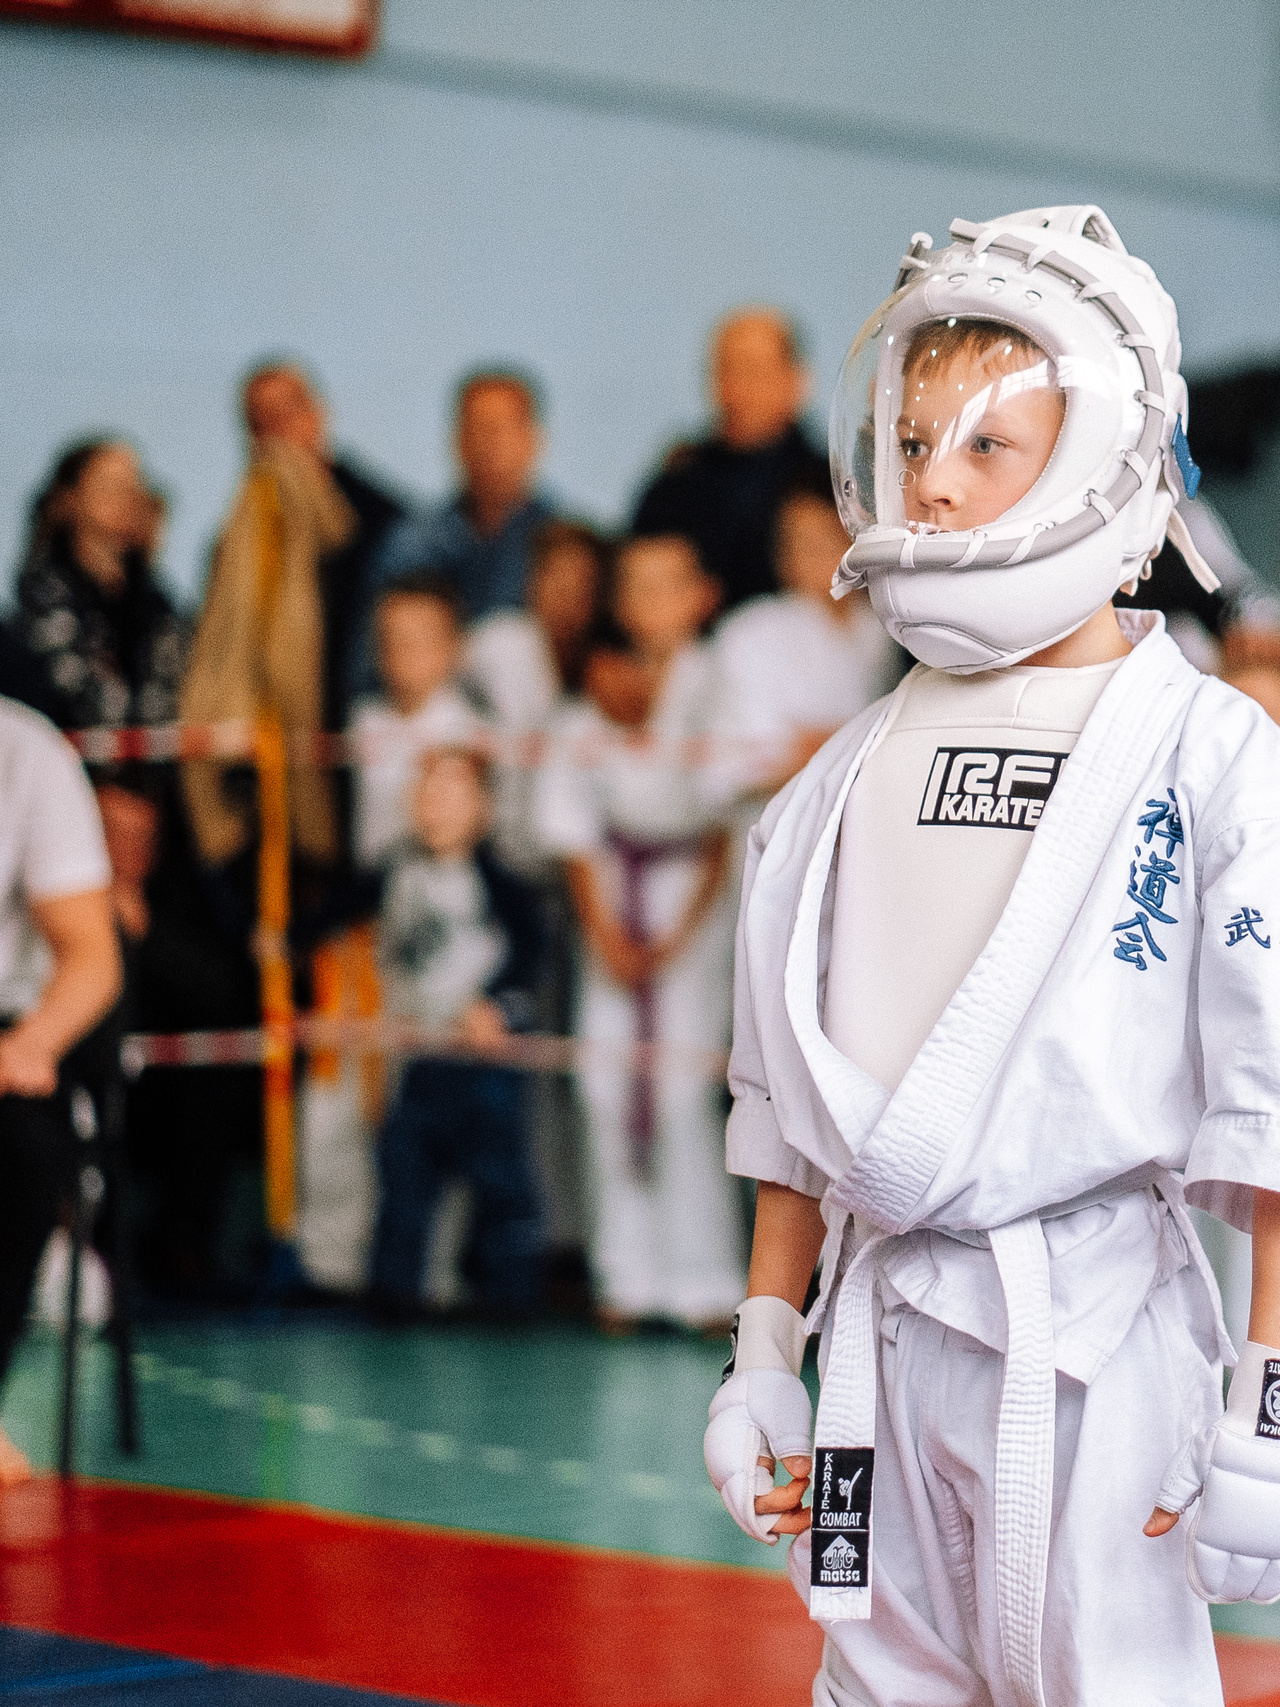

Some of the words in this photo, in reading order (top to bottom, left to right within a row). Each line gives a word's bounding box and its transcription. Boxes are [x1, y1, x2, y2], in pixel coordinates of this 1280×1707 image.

[938, 793, 1045, 826] KARATE
[821, 1452, 834, 1510] KARATE
[820, 1511, 862, 1527] COMBAT
[820, 1569, 861, 1583] matsa
